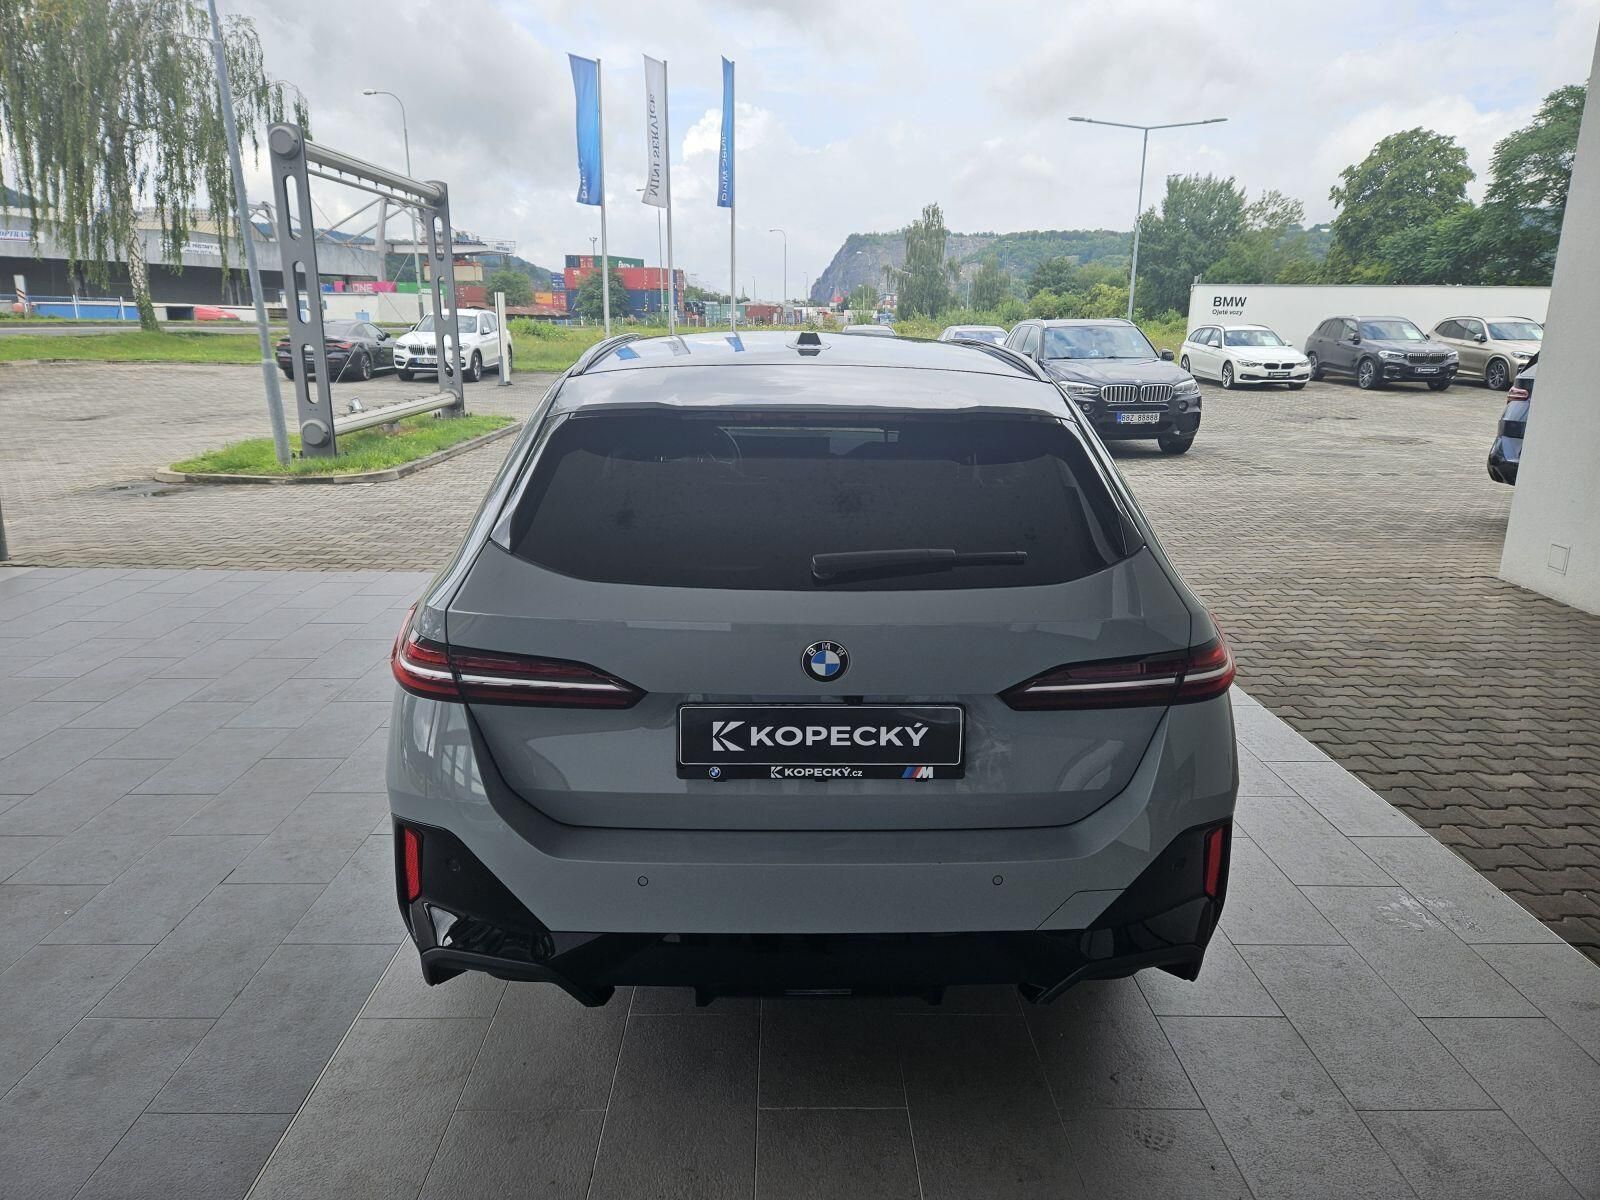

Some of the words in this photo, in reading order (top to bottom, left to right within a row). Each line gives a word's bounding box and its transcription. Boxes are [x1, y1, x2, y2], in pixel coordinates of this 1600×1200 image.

[1213, 296, 1247, 307] BMW
[807, 642, 845, 657] BMW
[750, 722, 929, 747] KOPECKÝ
[784, 766, 863, 778] KOPECKÝ.cz
